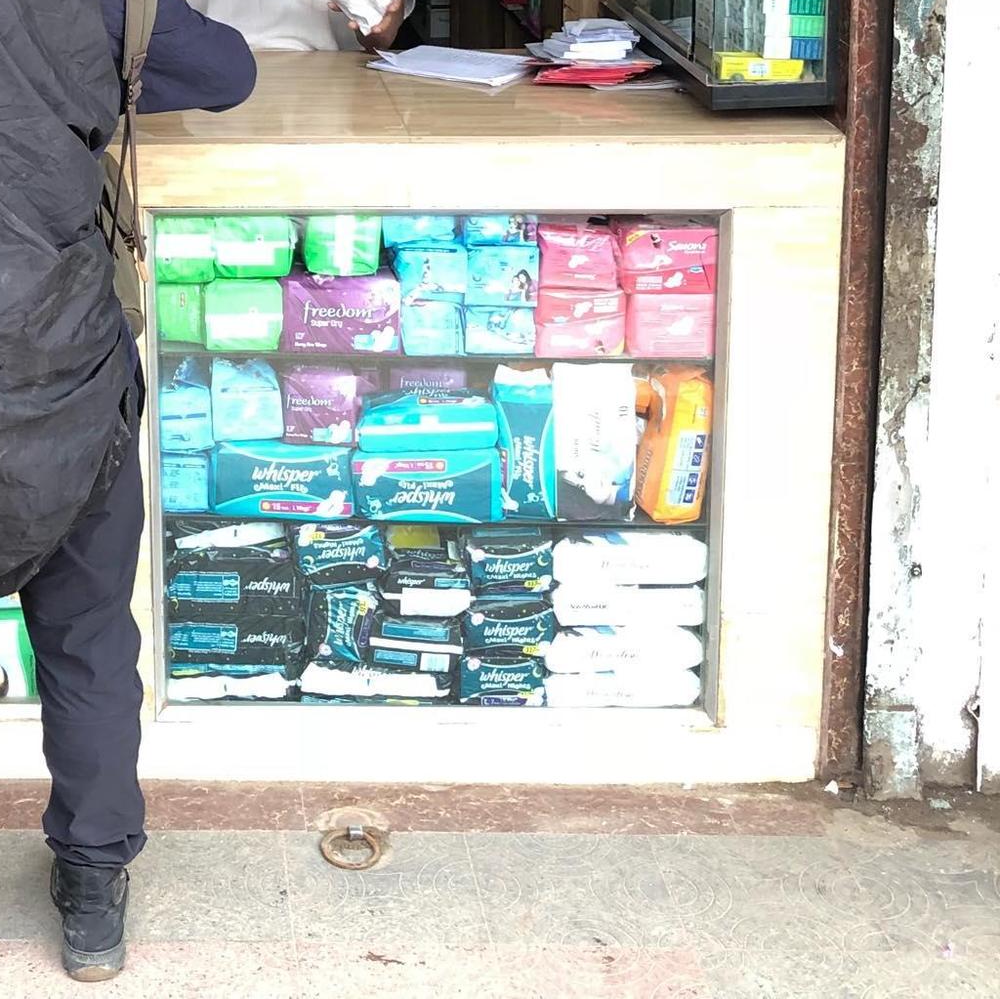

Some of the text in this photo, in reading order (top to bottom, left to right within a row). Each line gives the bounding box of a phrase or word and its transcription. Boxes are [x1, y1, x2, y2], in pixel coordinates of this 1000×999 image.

[304, 300, 372, 324] freedom
[287, 394, 333, 409] freedom
[523, 435, 540, 490] whisper
[252, 461, 320, 487] whisper
[388, 485, 456, 511] whisper
[319, 546, 366, 561] whisper
[485, 559, 535, 578] whisper
[245, 576, 291, 595] whisper
[483, 622, 534, 640] whisper
[479, 668, 530, 685] whisper
